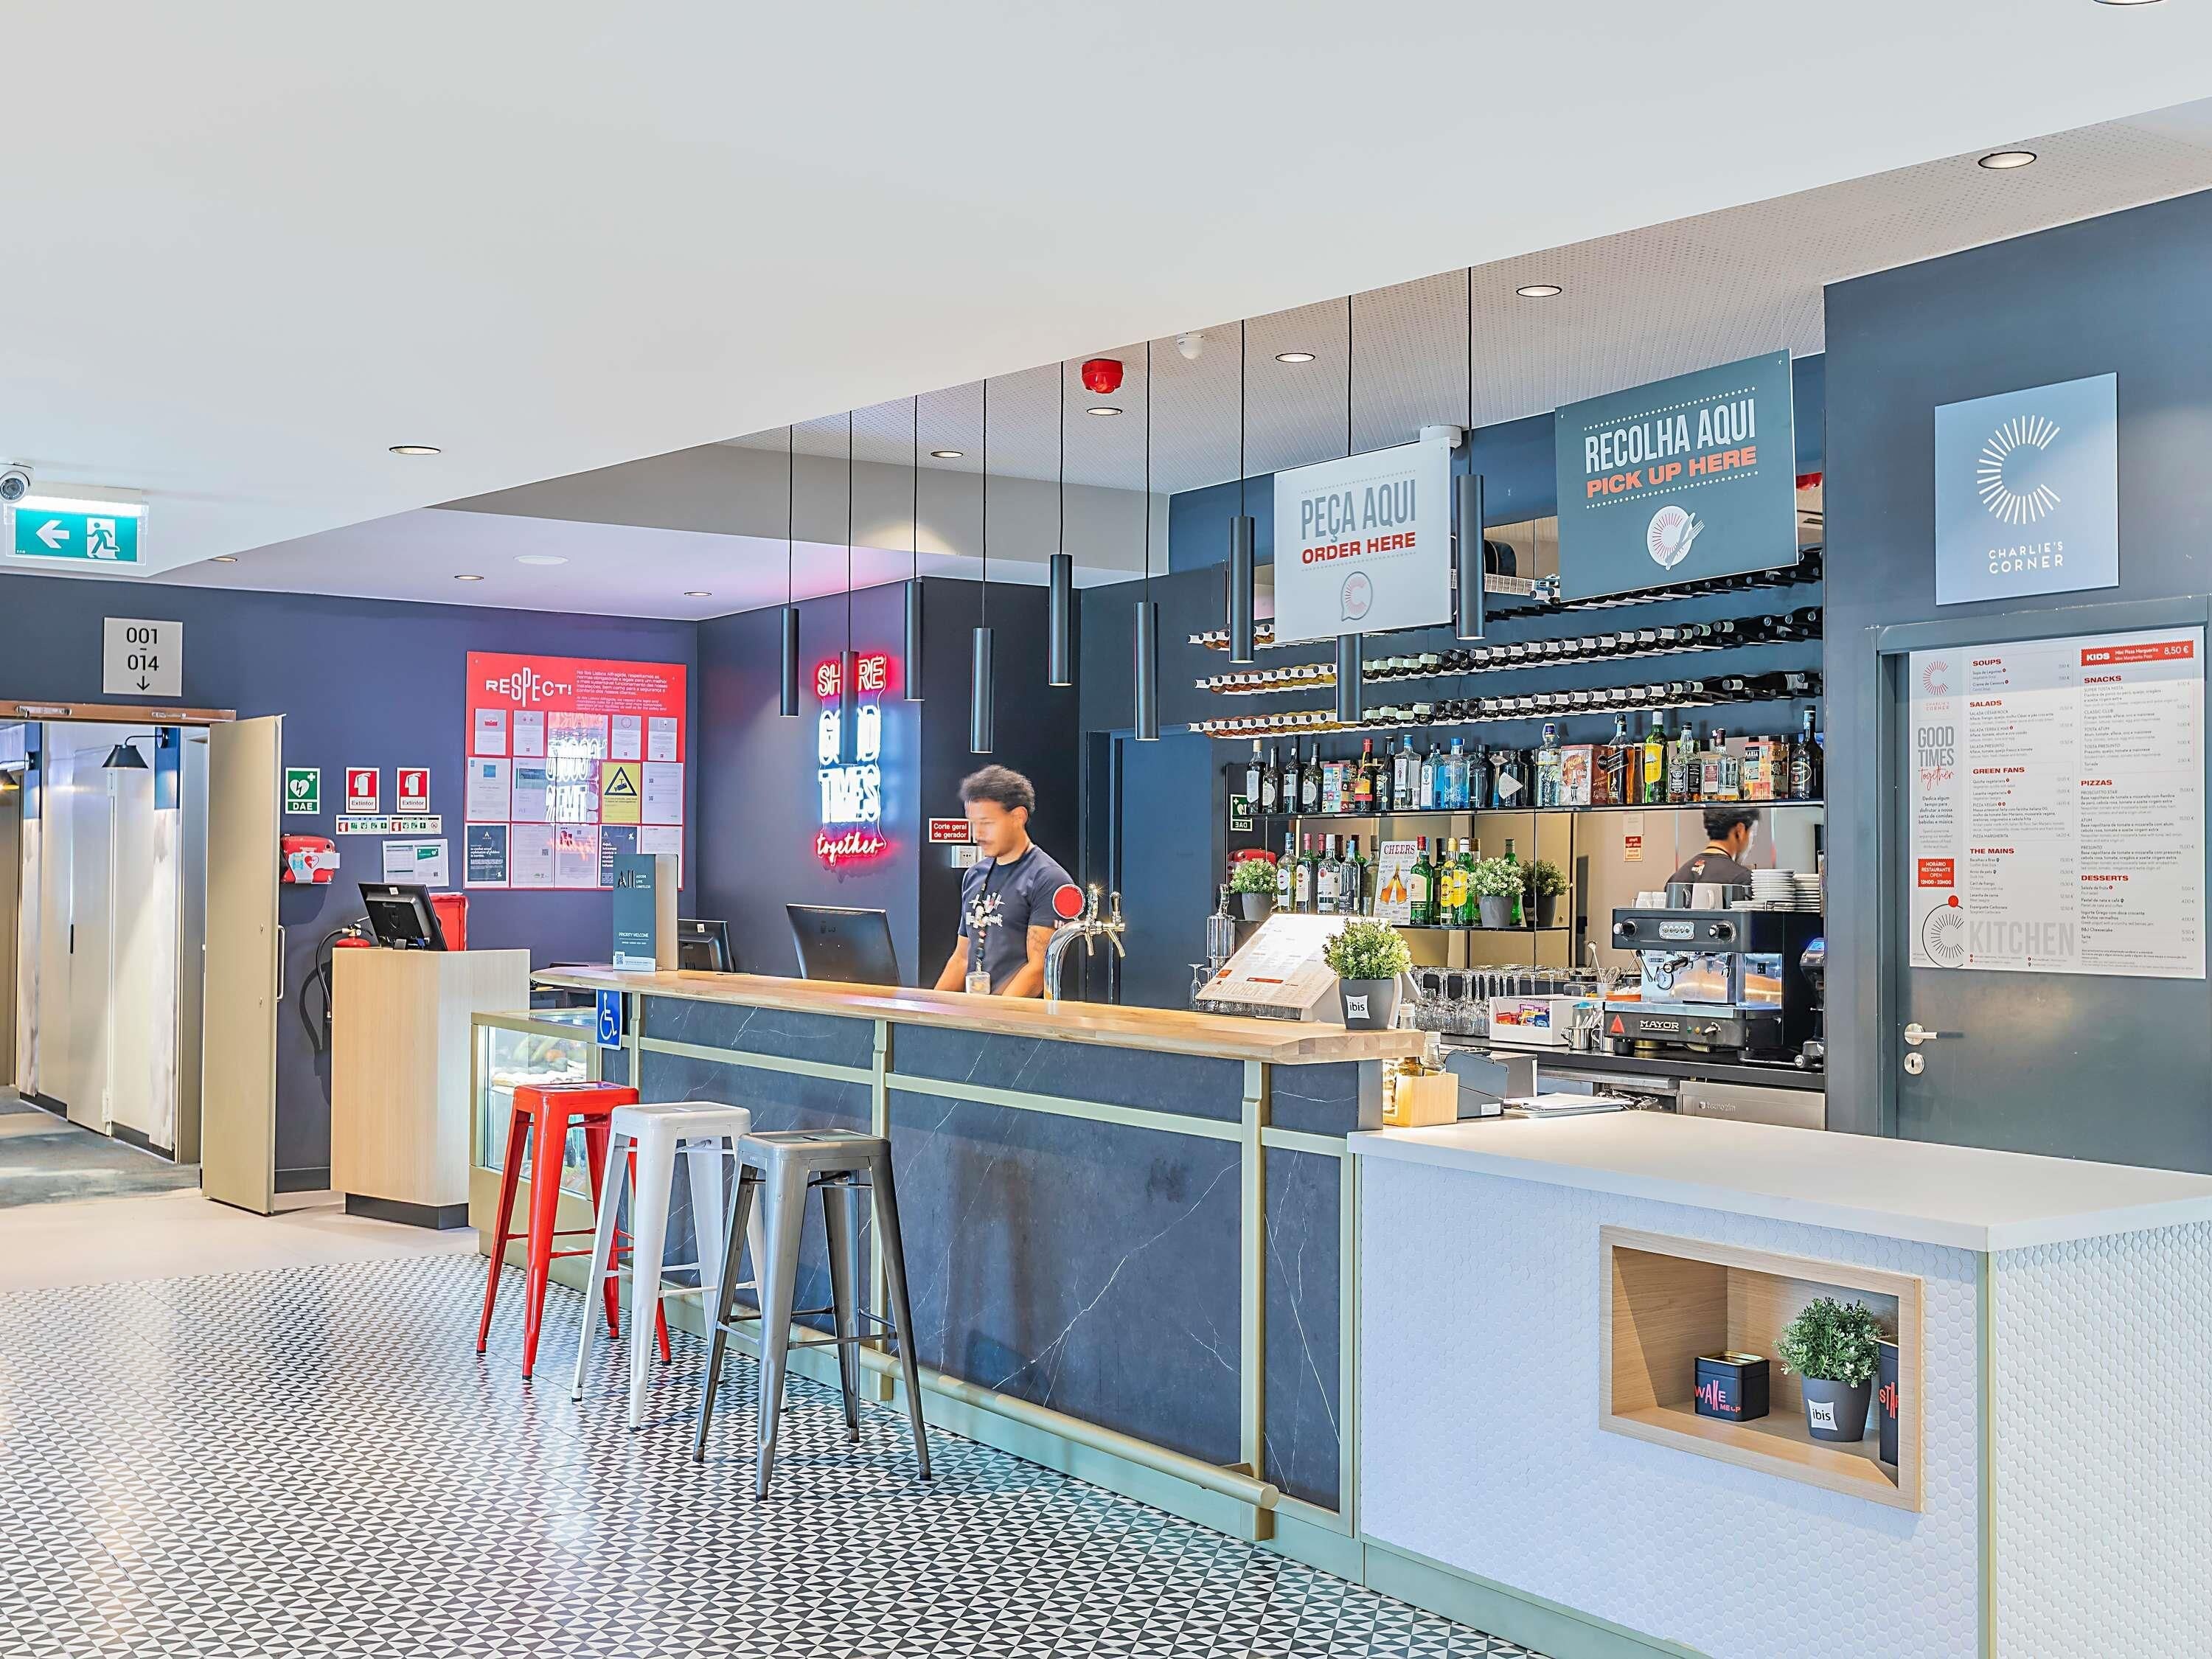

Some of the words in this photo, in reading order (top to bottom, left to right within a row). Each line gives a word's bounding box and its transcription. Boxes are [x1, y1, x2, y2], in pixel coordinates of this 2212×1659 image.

[1585, 414, 1690, 473] RECOLHA
[1697, 399, 1755, 449] AQUI
[1587, 470, 1642, 498] PICK
[1649, 463, 1681, 485] UP
[1689, 446, 1757, 477] HERE
[1302, 491, 1355, 543] PEÇA
[1363, 479, 1415, 529] AQUI
[1302, 541, 1360, 564] ORDER
[1367, 532, 1415, 553] HERE
[1989, 542, 2063, 559] CHARLIE'S
[1989, 554, 2063, 574] CORNER
[126, 627, 158, 644] 001
[127, 654, 159, 672] 014
[2086, 653, 2110, 661] KIDS
[2164, 647, 2181, 655] 8,50
[817, 656, 885, 697] SHRE
[2084, 675, 2122, 684] SNACKS
[486, 667, 571, 707] RESPECT!
[1918, 726, 1954, 748] GOOD
[1918, 748, 1954, 767] TIMES
[819, 765, 881, 823] TIMES
[944, 831, 967, 839] gerador
[952, 822, 967, 832] geral
[817, 832, 884, 866] together
[1384, 844, 1415, 854] CHEERS
[1970, 921, 2074, 956] KITCHEN
[1349, 1001, 1365, 1012] ibis
[1640, 1020, 1680, 1029] MAYOR
[1695, 1380, 1726, 1411] WAKE
[1812, 1408, 1831, 1421] ibis
